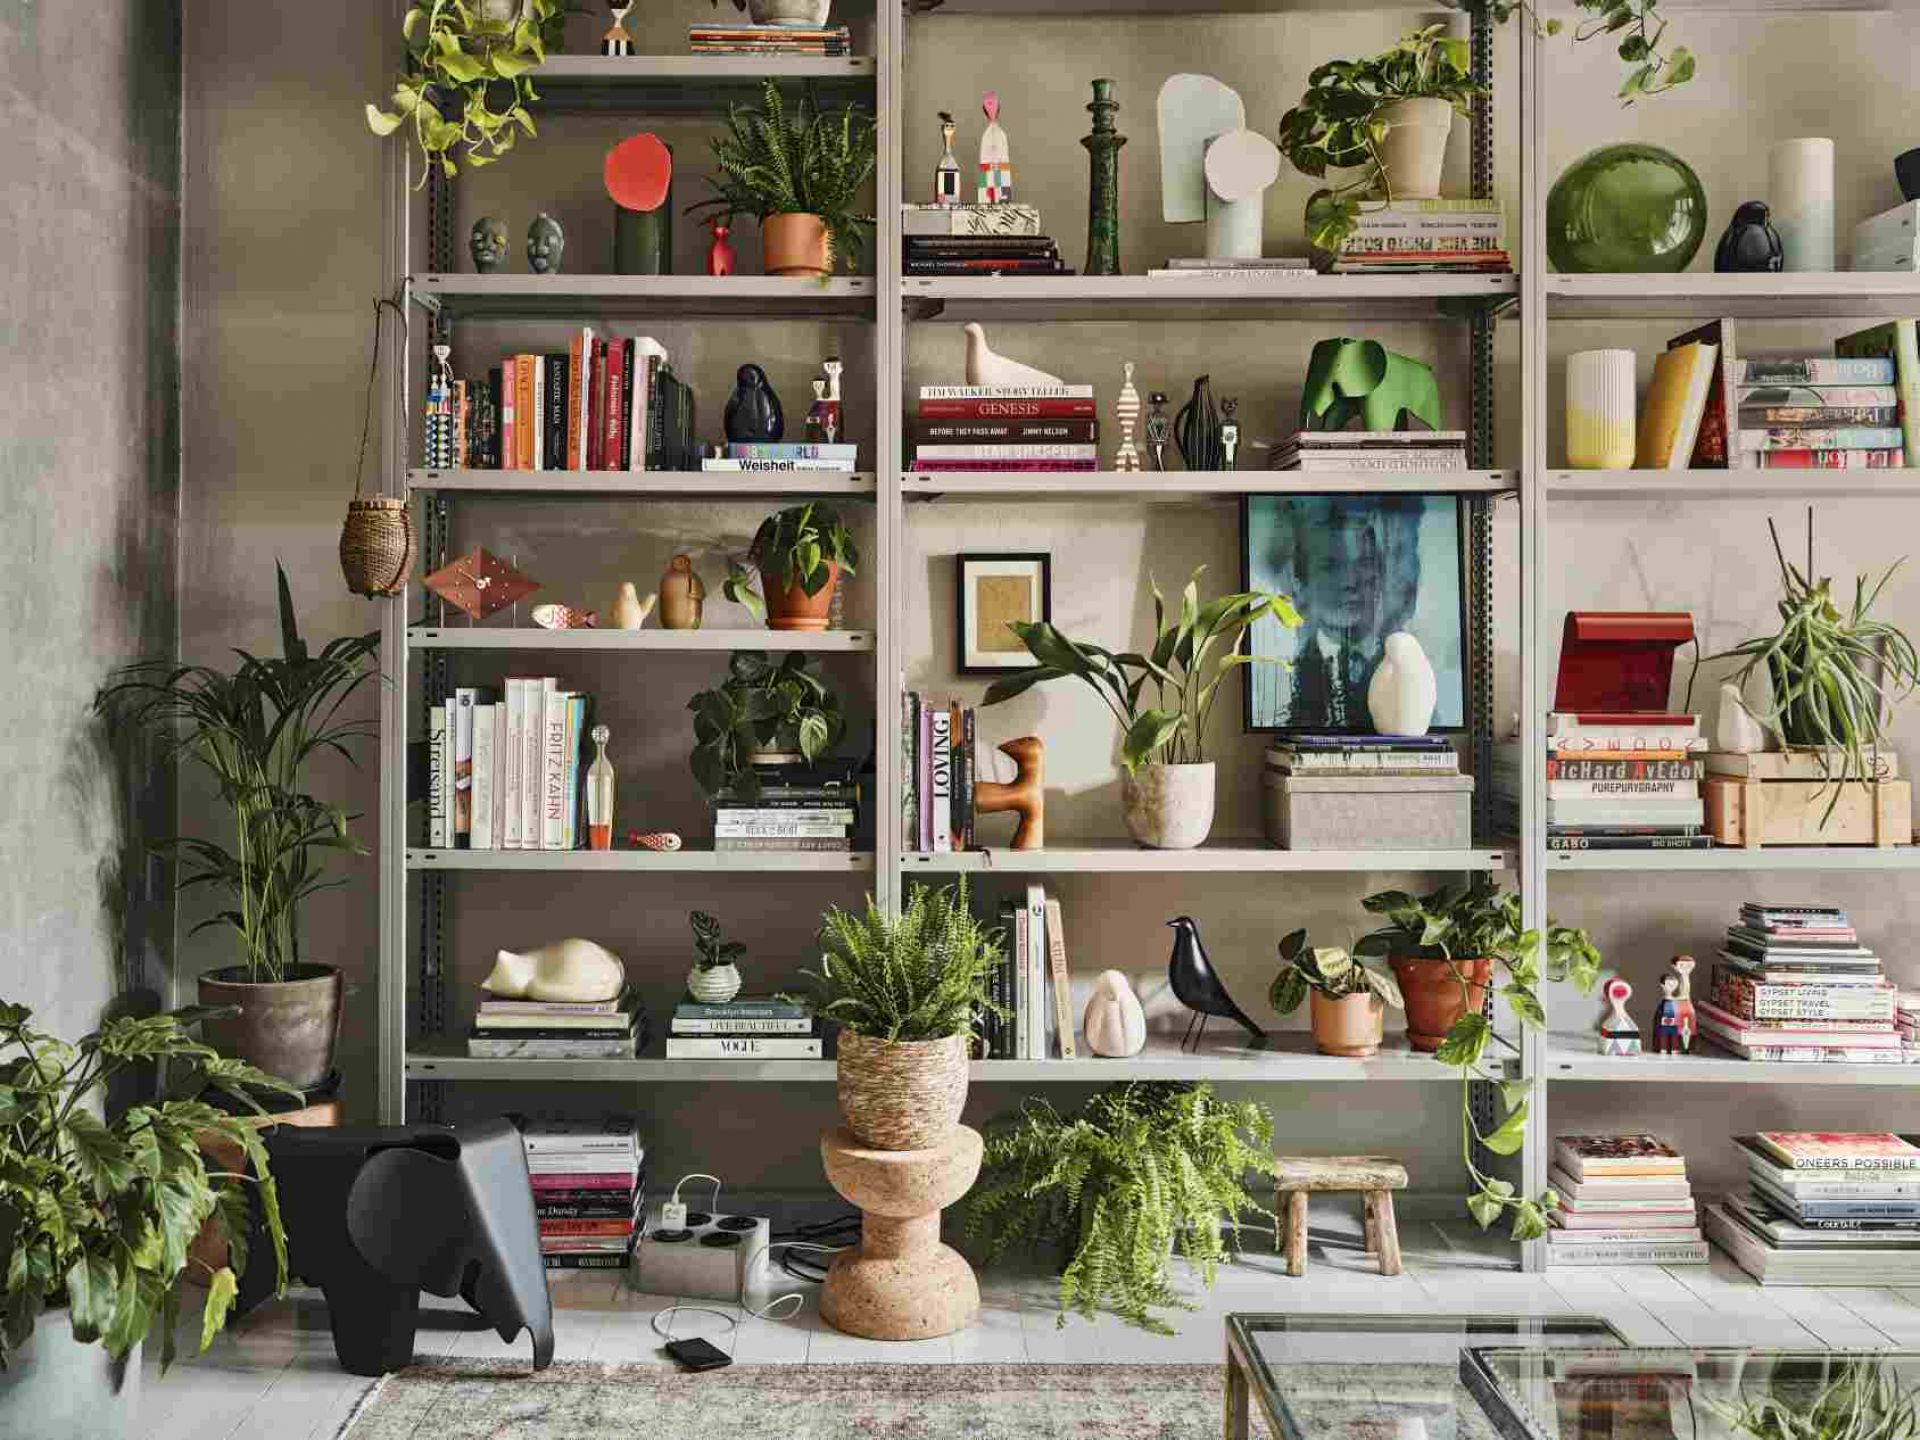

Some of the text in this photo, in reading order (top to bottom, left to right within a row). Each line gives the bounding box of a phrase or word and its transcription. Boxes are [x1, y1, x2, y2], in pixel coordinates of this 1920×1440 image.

[978, 403, 1040, 415] GENESIS
[739, 460, 795, 471] Weisheit
[934, 719, 950, 798] LOVING
[430, 729, 446, 819] Streisand
[547, 722, 564, 820] FRITZ KAHN
[1552, 838, 1589, 848] GABO
[1760, 1000, 1795, 1008] GYPSET
[1855, 1158, 1916, 1169] POSSIBLE
